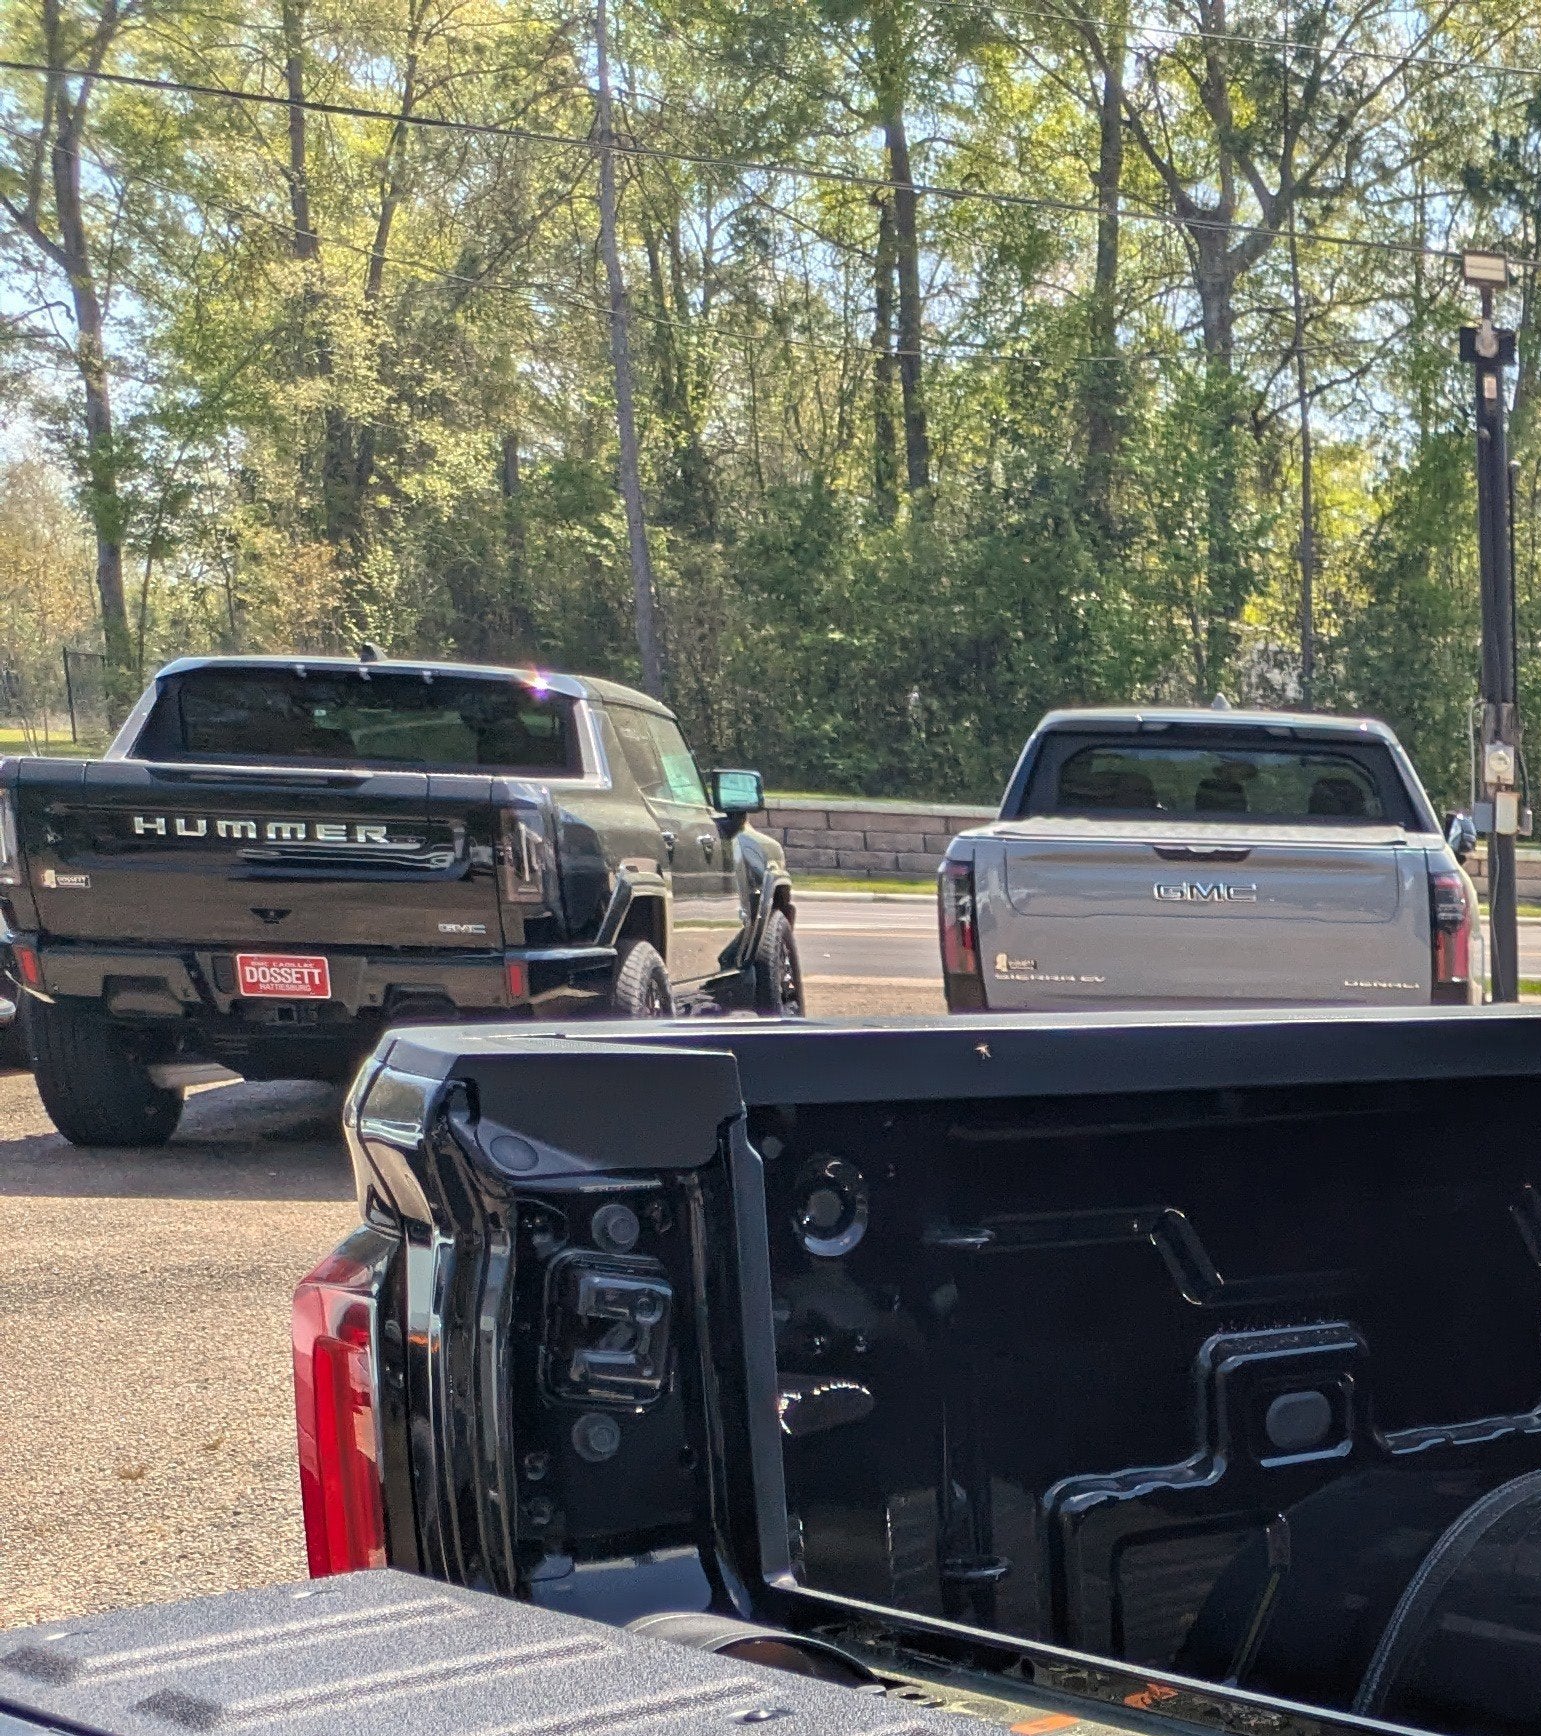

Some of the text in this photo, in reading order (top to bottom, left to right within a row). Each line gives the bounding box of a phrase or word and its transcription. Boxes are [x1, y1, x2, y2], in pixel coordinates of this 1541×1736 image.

[134, 816, 390, 844] HUMMER
[1152, 881, 1257, 902] GMC
[437, 923, 486, 934] GMC
[245, 966, 322, 985] DOSSETT
